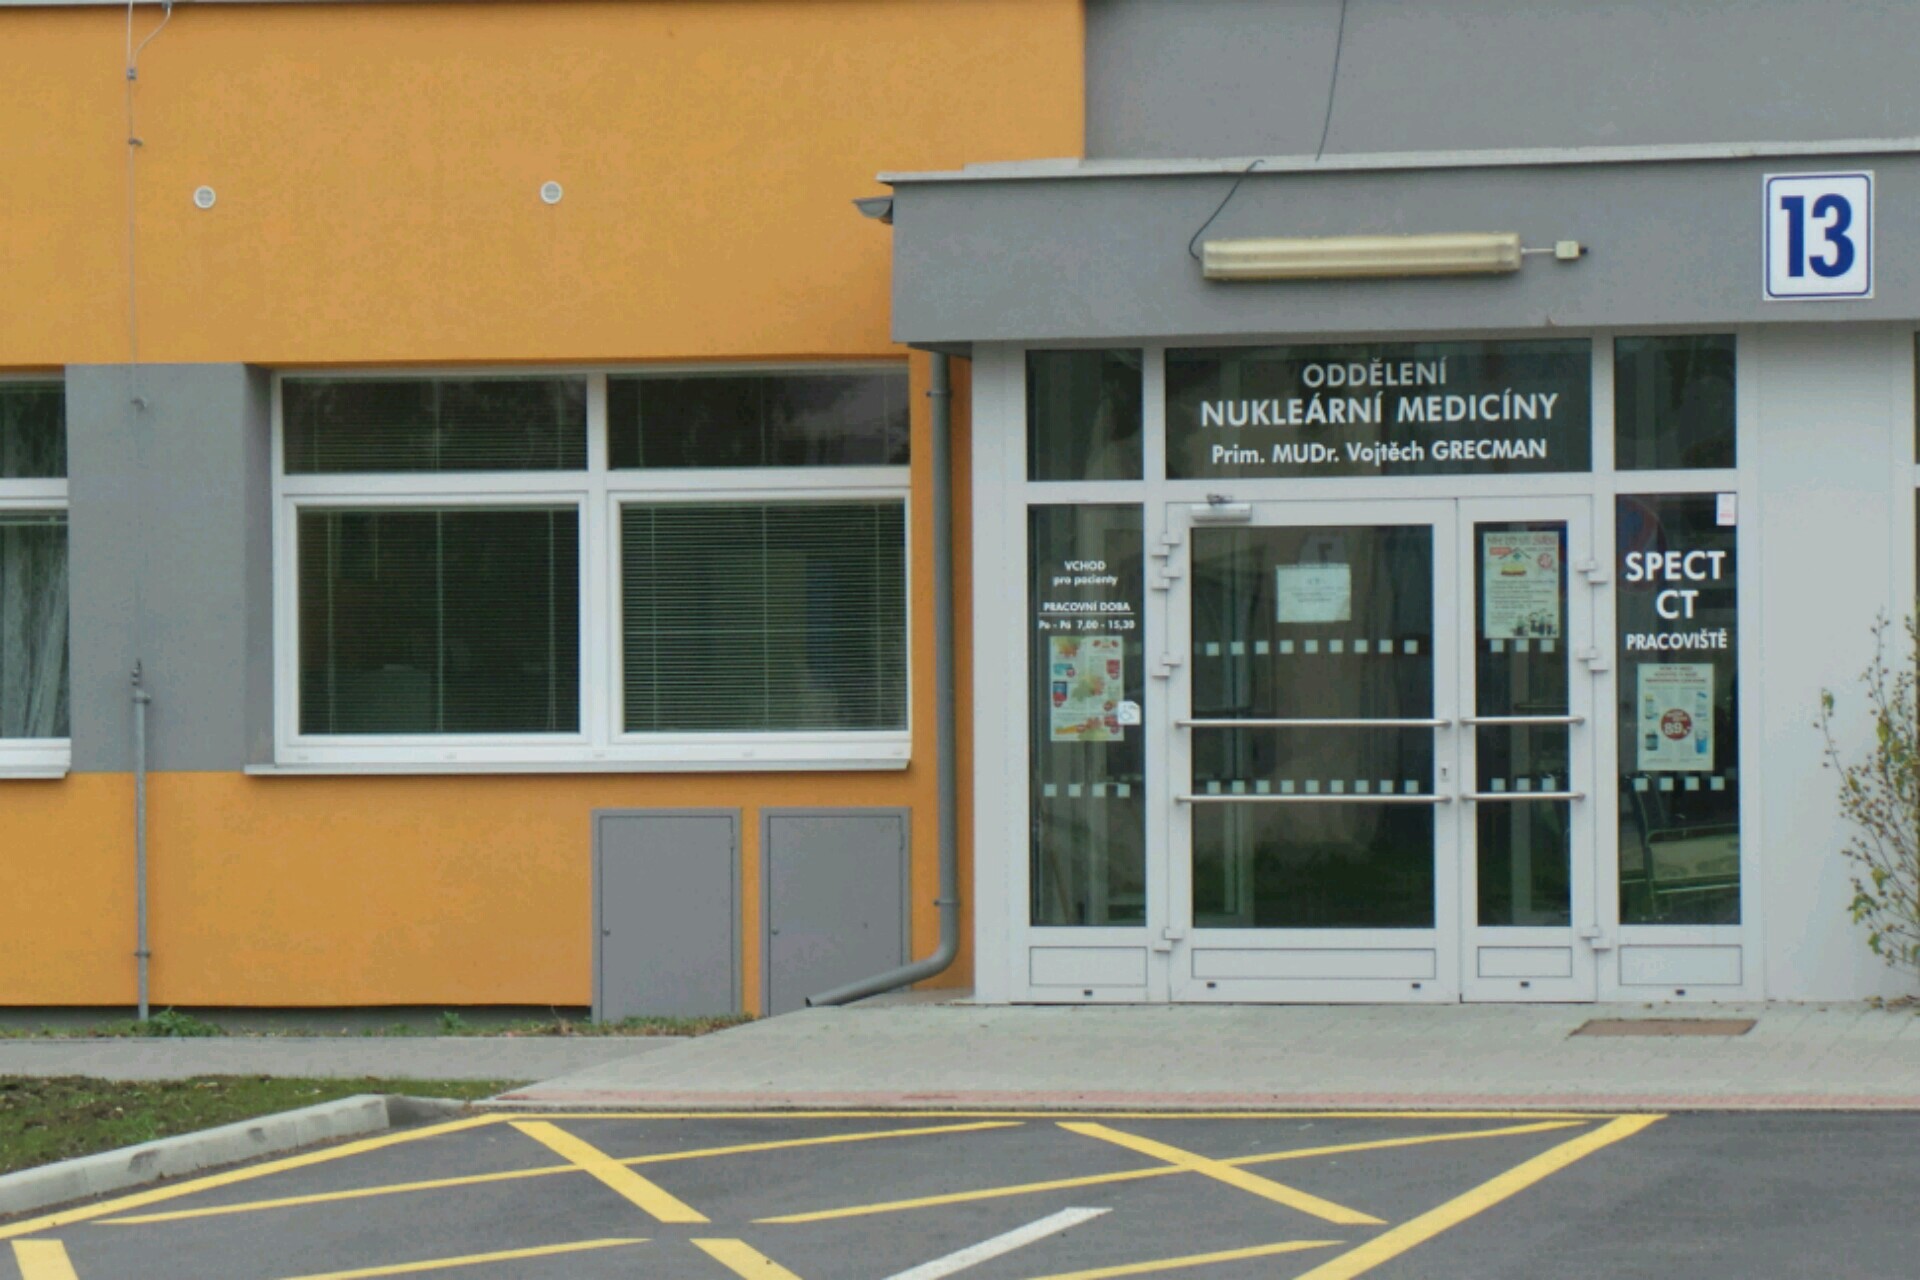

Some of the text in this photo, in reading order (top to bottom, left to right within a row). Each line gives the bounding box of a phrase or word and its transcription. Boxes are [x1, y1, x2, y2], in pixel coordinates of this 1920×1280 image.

[1780, 193, 1855, 278] 13
[1303, 358, 1447, 388] ODDĚLENÍ
[1200, 388, 1559, 427] NUKLEÁRNÍ MEDICÍNY
[1212, 439, 1547, 467] Prim. MUDr. Vojtěch GRECMAN
[1064, 560, 1107, 571] VCHOD
[1625, 550, 1726, 581] SPECT
[1053, 574, 1118, 587] pro pacienty
[1043, 601, 1131, 611] PRACOVNÍ DOBA
[1656, 589, 1699, 619] CT
[1626, 628, 1728, 649] PRACOVIŠTĚ
